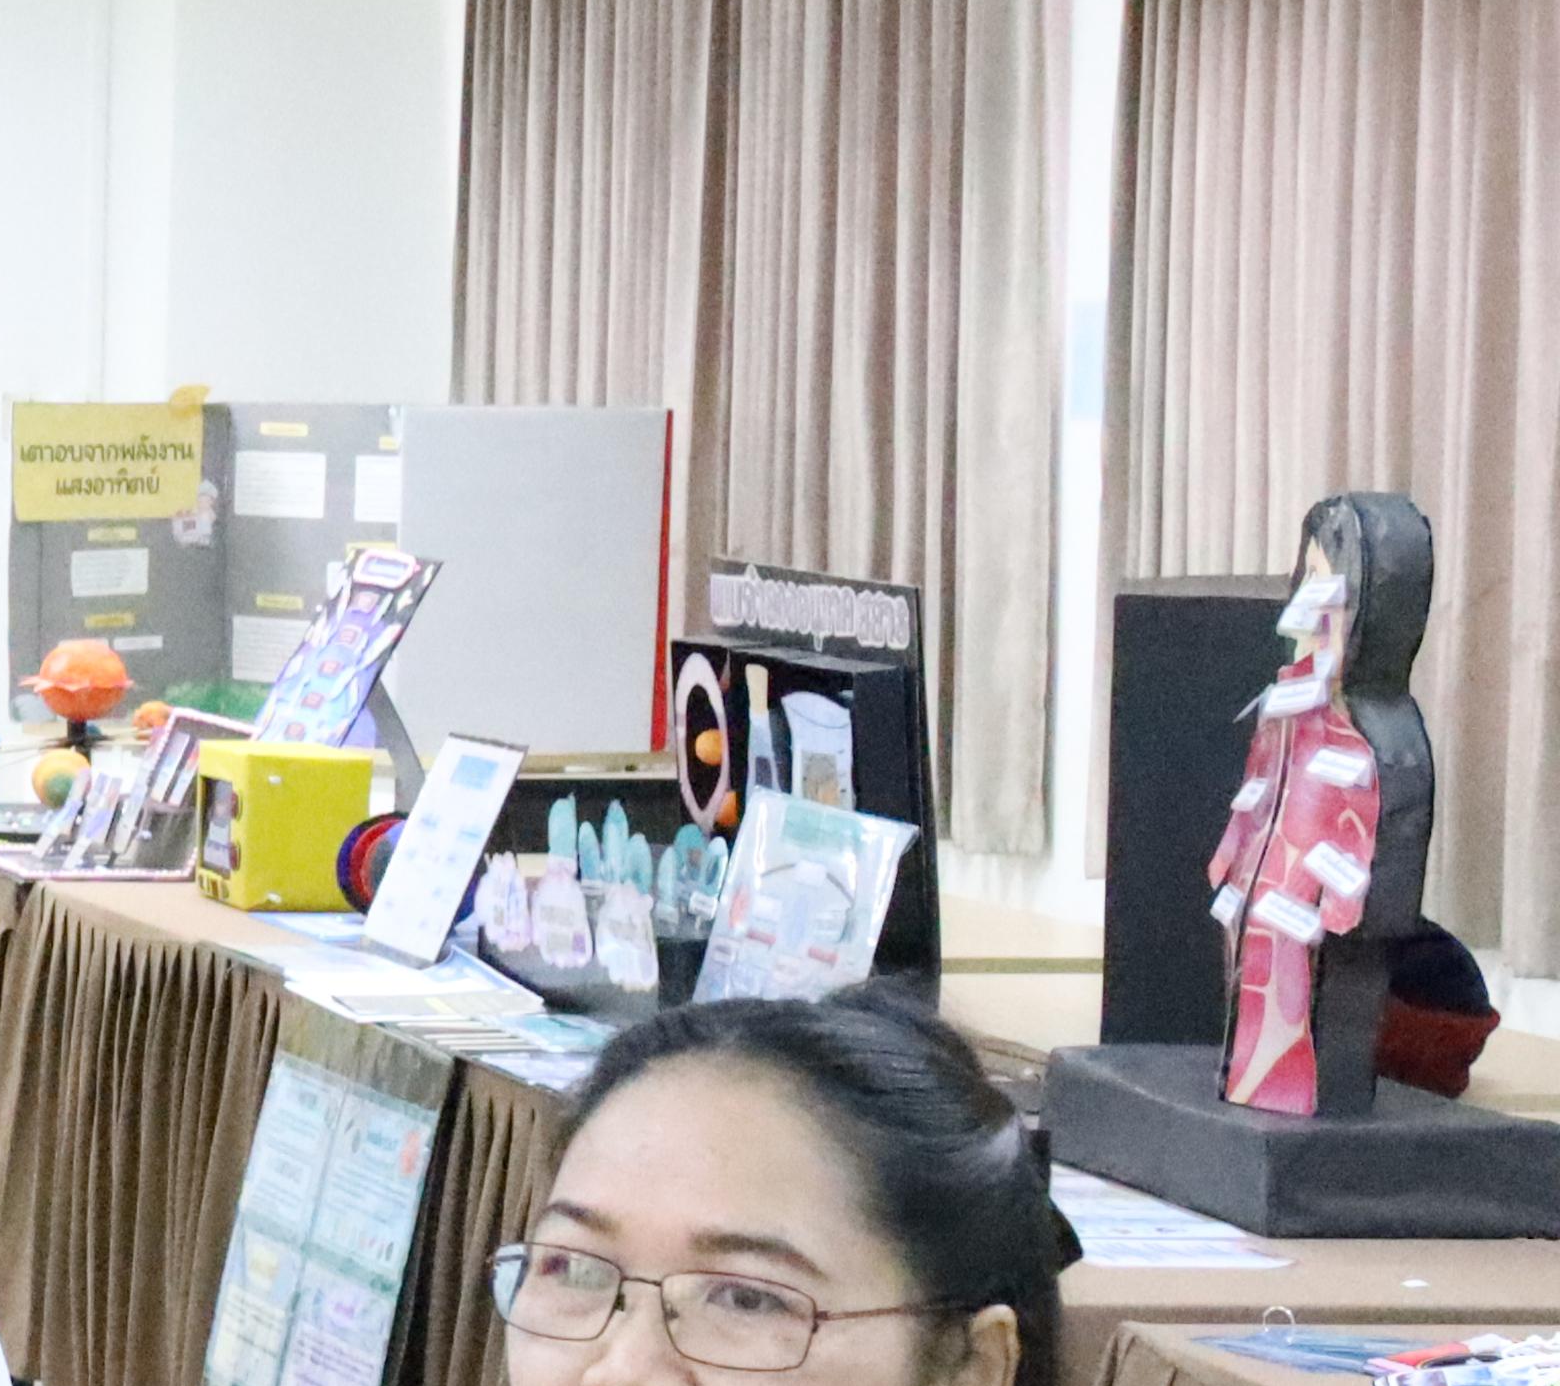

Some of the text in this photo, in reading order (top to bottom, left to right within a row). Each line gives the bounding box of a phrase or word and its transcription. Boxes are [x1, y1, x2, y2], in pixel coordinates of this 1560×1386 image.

[20, 435, 194, 463] เตาอบจากพลังงาน
[55, 466, 161, 496] แสงอาทิตย์
